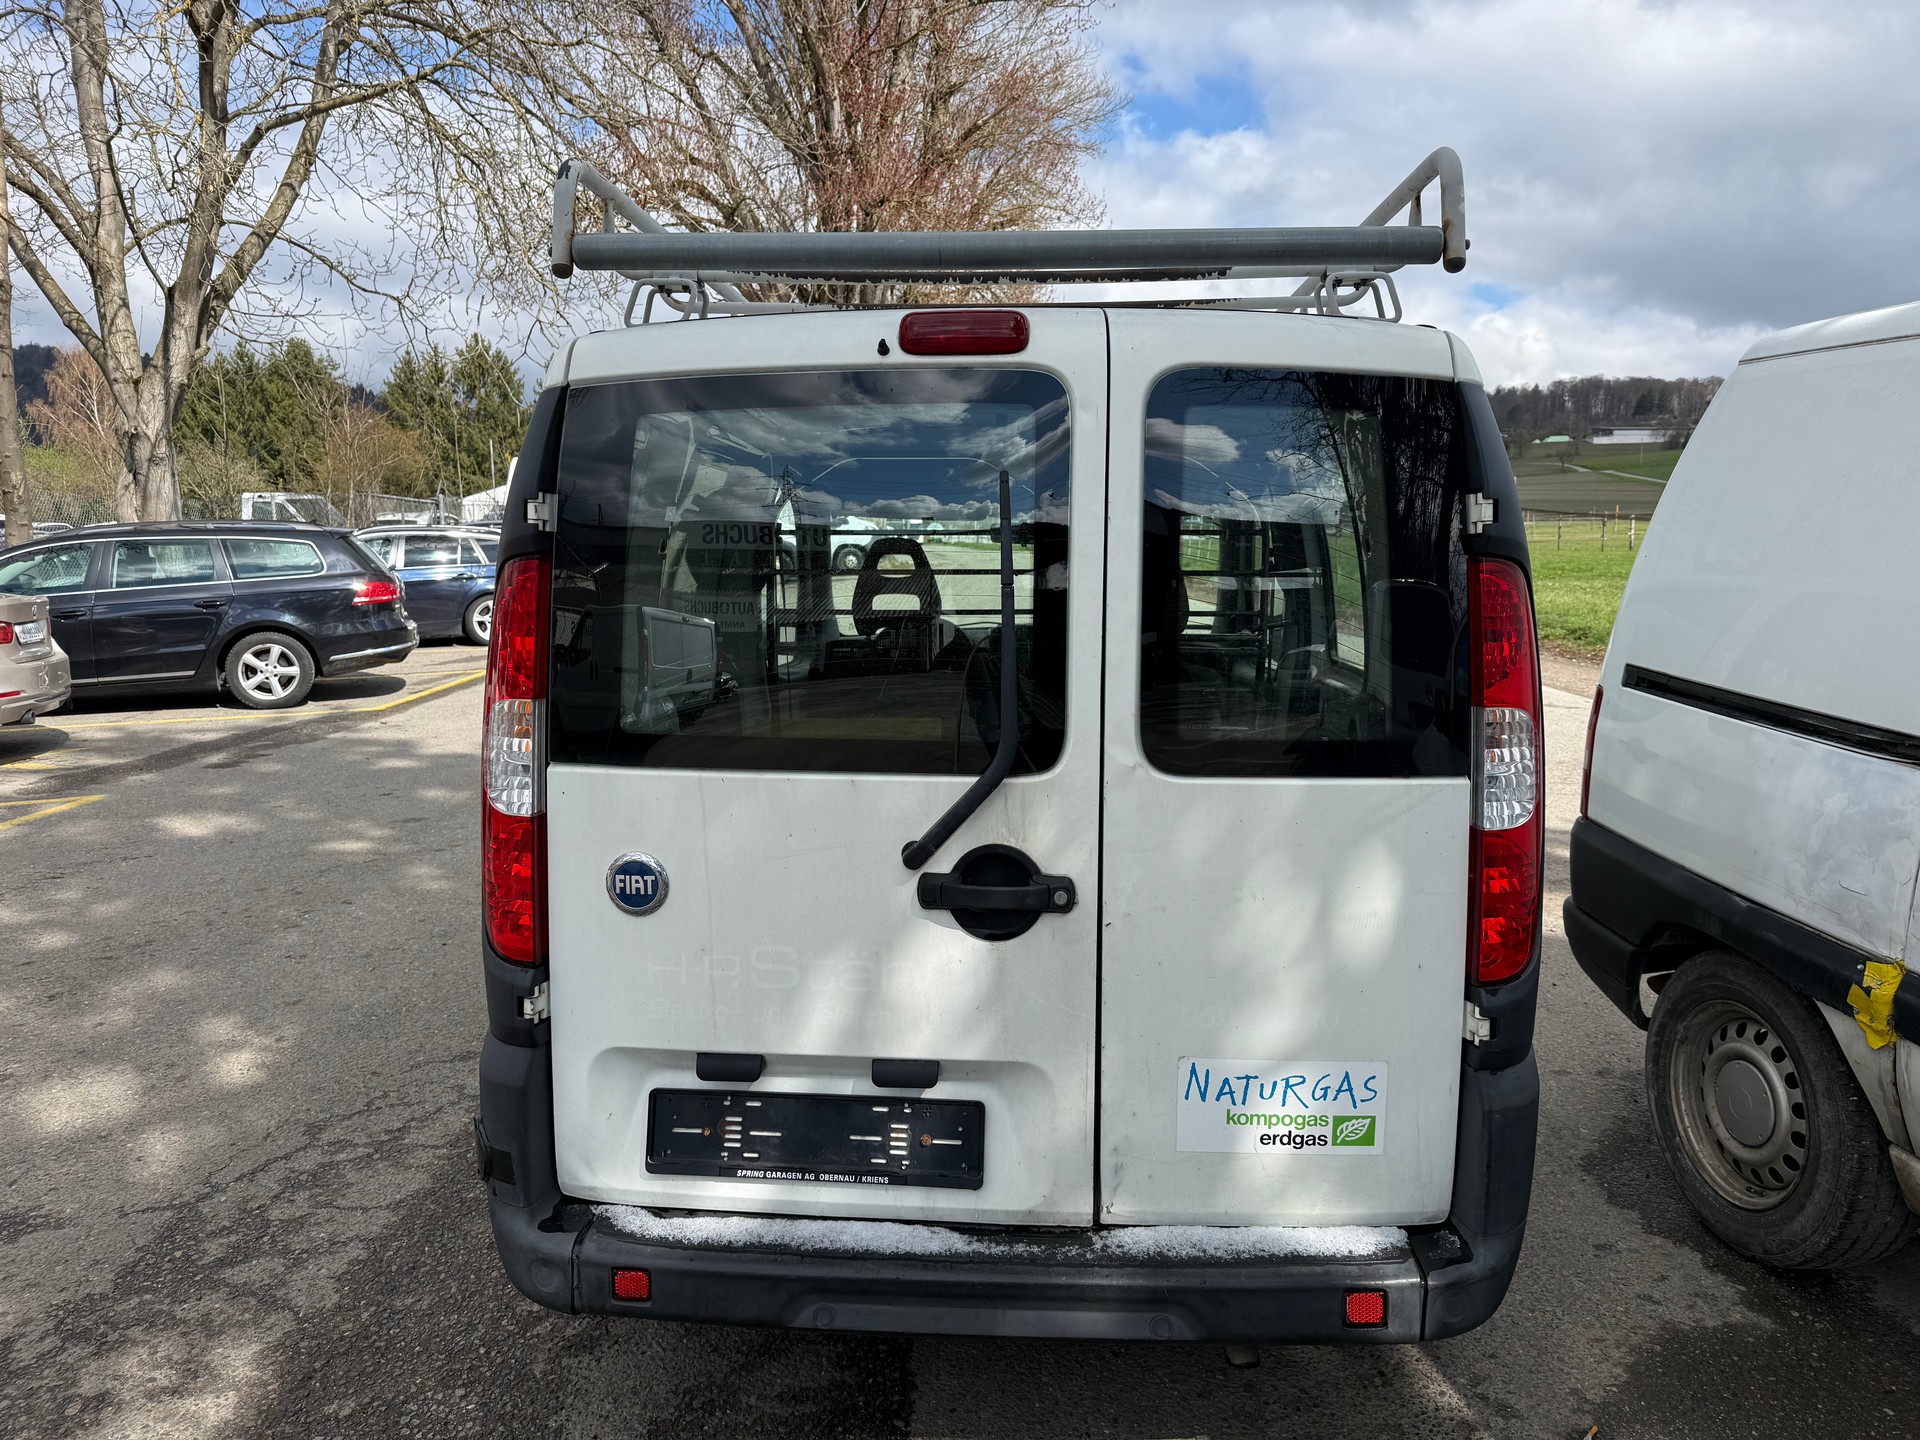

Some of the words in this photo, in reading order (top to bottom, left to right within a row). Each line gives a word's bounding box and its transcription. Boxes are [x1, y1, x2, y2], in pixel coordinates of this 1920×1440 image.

[615, 874, 656, 895] FIAT
[1184, 1062, 1378, 1110] NATURGAS
[1226, 1109, 1329, 1130] kompogas
[1259, 1130, 1328, 1149] erdgas
[736, 1170, 764, 1178] SPRING
[766, 1171, 802, 1180] GARAGEN
[819, 1174, 855, 1182] OBERNAU
[861, 1176, 889, 1184] KRIENS
